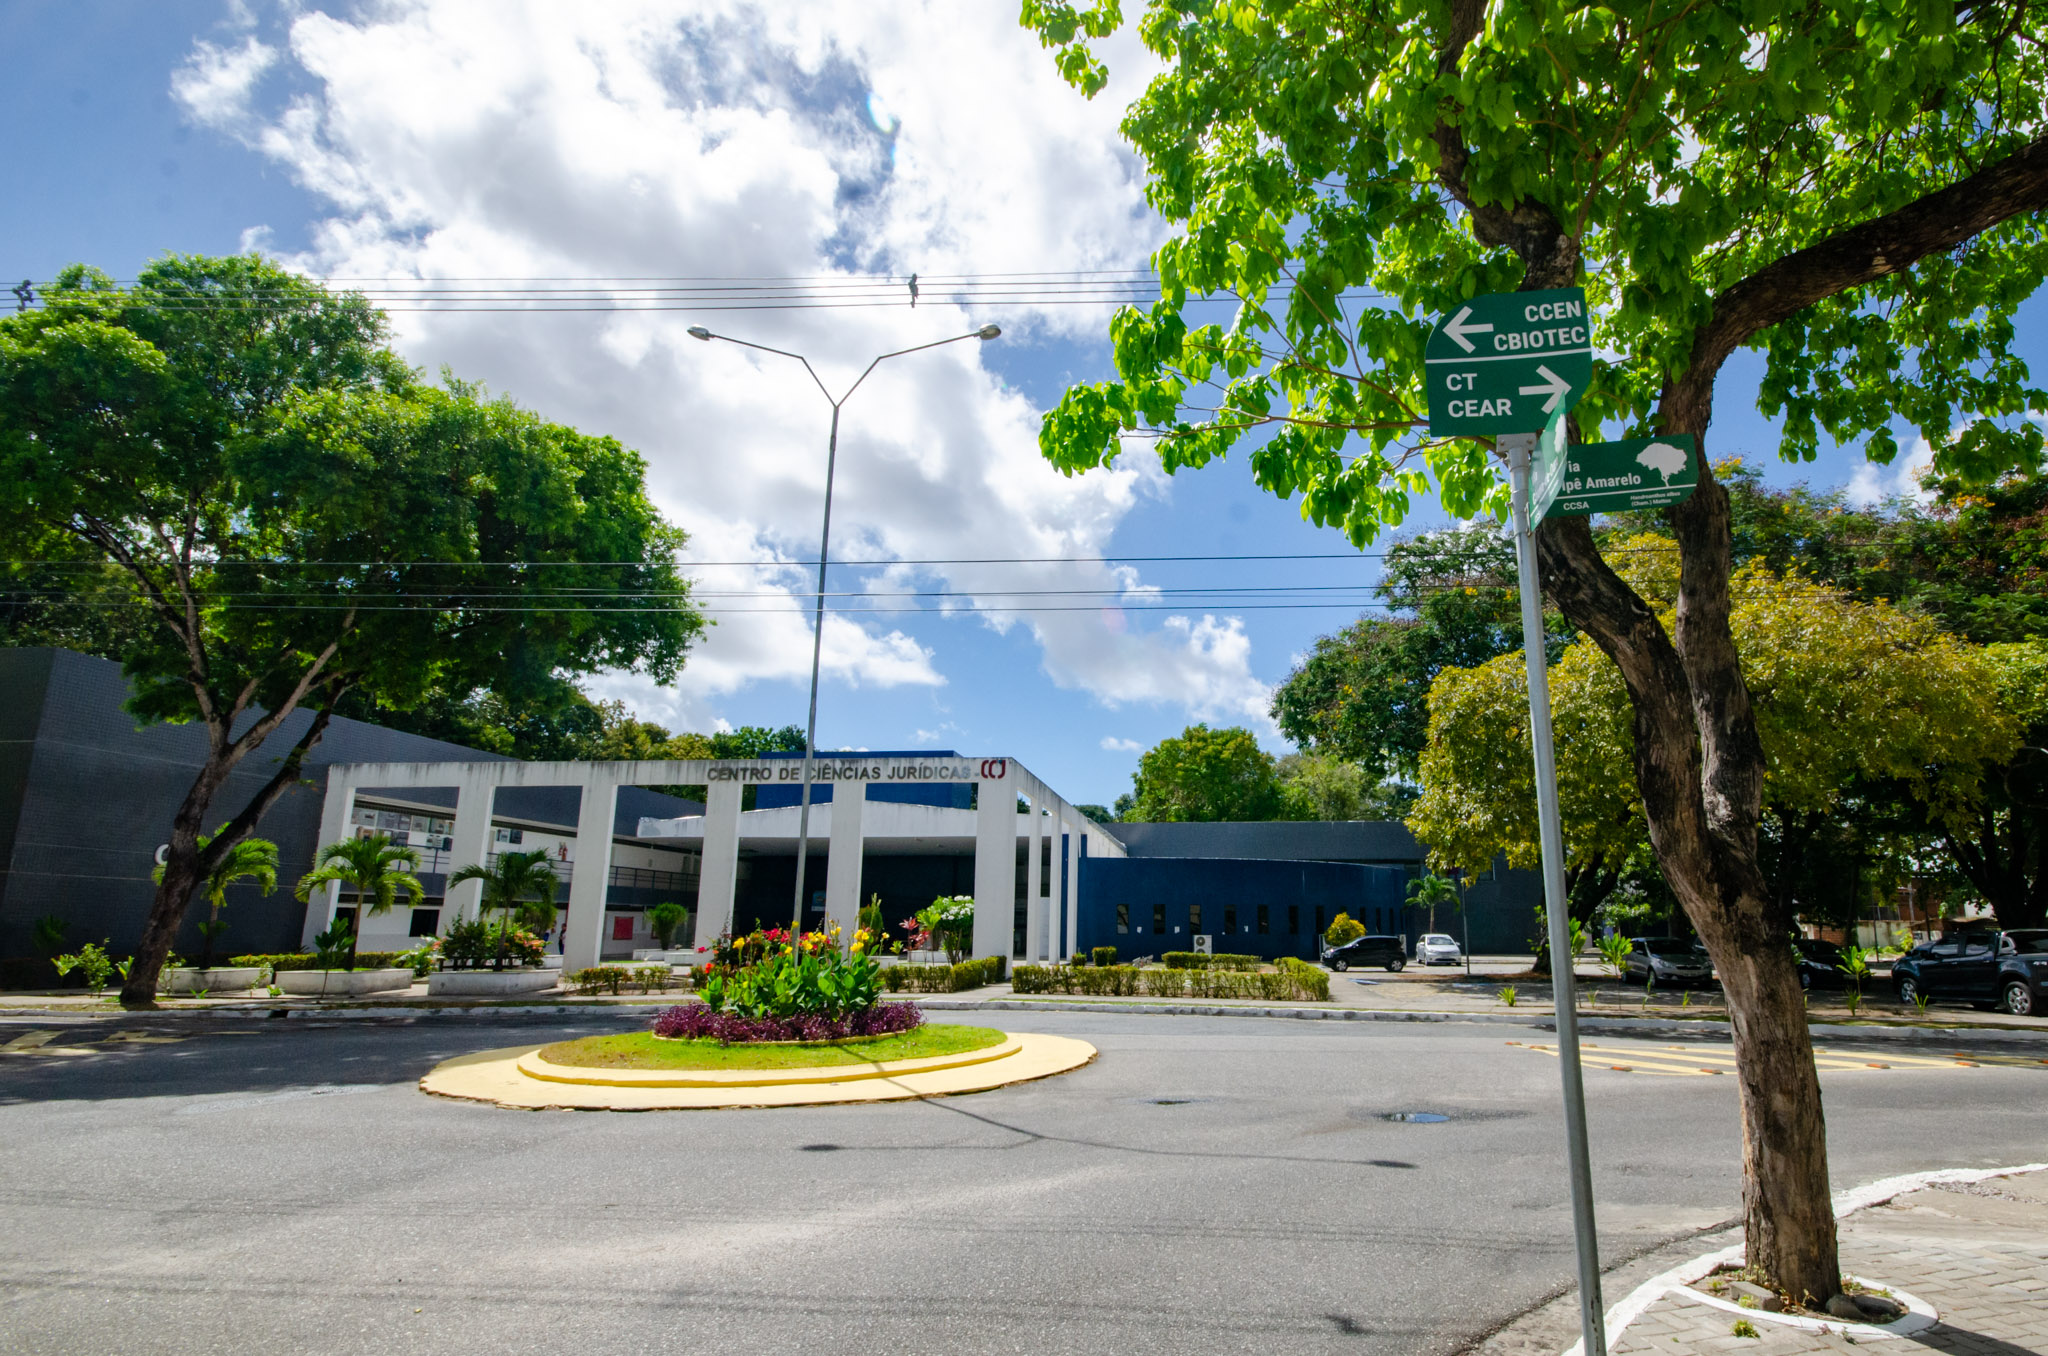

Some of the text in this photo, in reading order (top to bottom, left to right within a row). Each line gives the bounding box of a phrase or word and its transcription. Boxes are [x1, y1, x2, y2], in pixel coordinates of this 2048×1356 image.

[1525, 300, 1582, 323] CCEN
[1493, 326, 1587, 352] CBIOTEC
[1445, 373, 1478, 392] CT
[1447, 398, 1513, 418] CEAR
[1567, 461, 1581, 473] ia
[1585, 472, 1642, 489] Amarelo
[1563, 501, 1590, 511] CCSA
[707, 767, 772, 781] CENTRO
[779, 767, 800, 781] DE
[887, 762, 972, 780] JURÍDICAS
